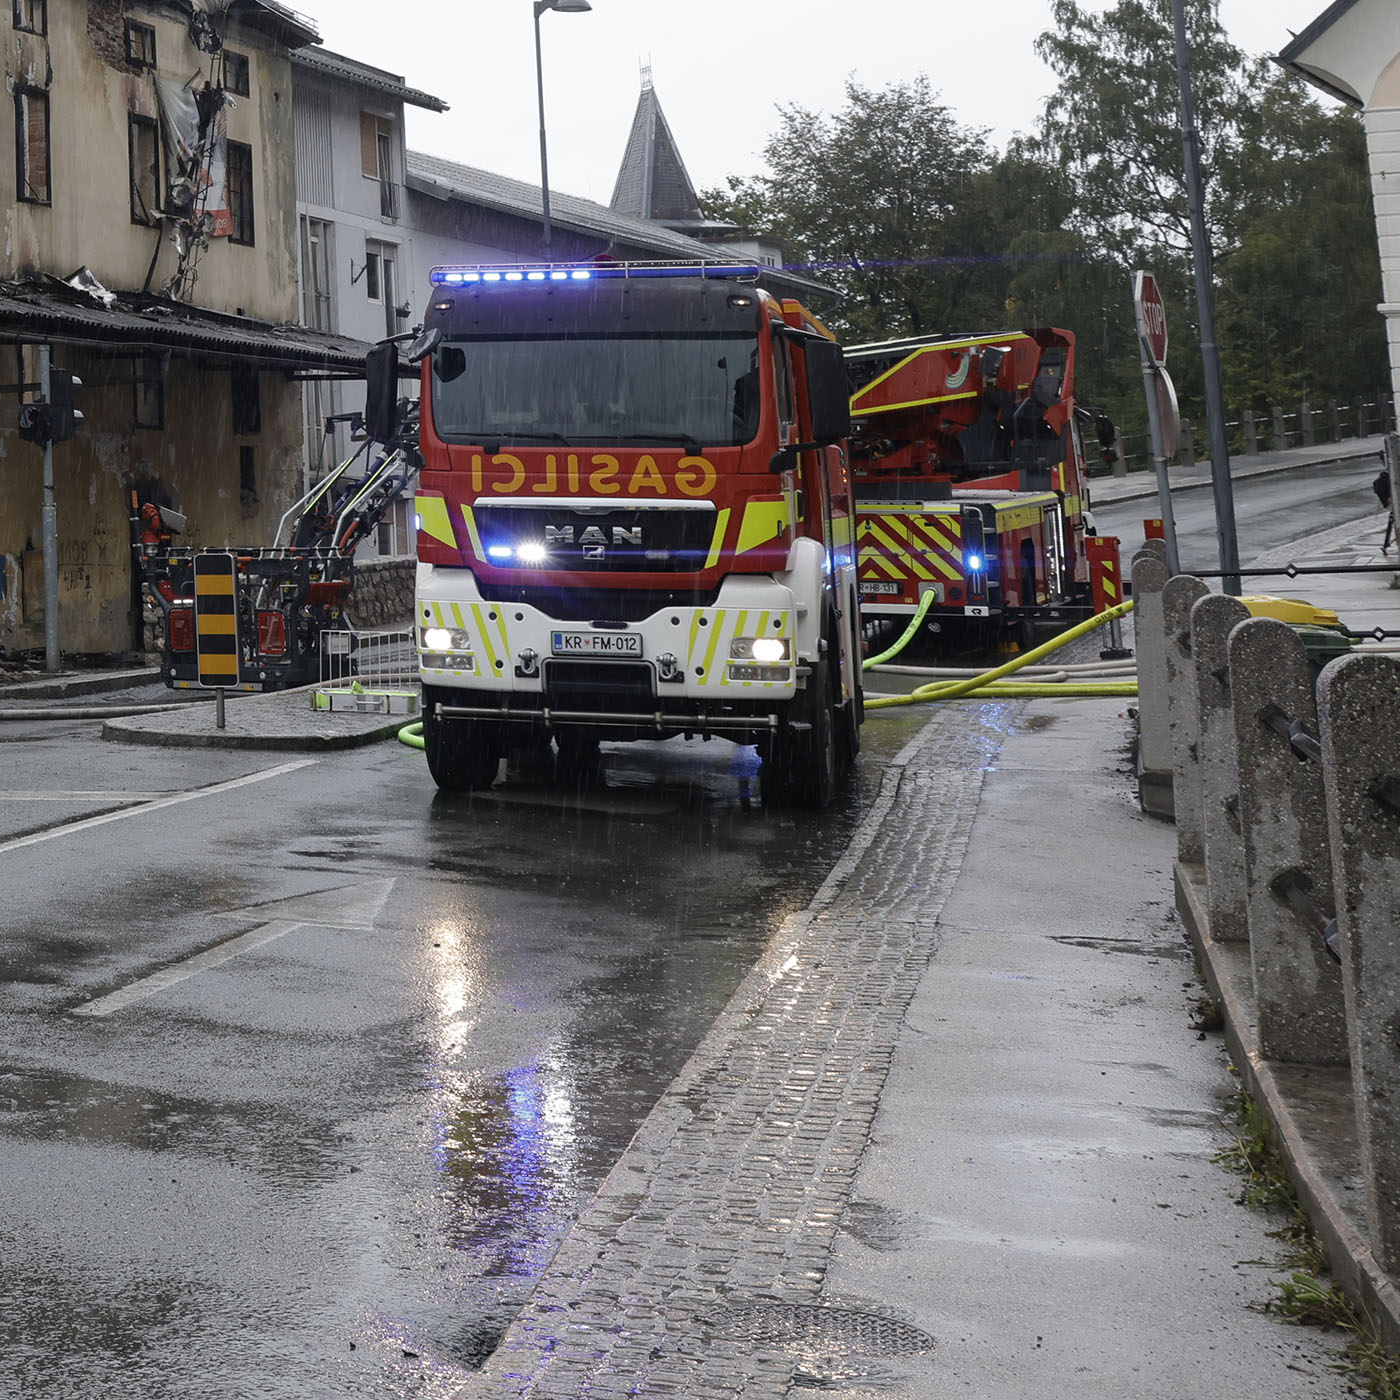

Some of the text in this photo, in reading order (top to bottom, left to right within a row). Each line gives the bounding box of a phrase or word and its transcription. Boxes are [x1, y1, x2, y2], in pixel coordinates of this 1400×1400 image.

[1143, 302, 1163, 335] STOP
[545, 525, 642, 544] MAN
[869, 583, 895, 592] HB-131
[564, 636, 637, 651] KR FM-012
